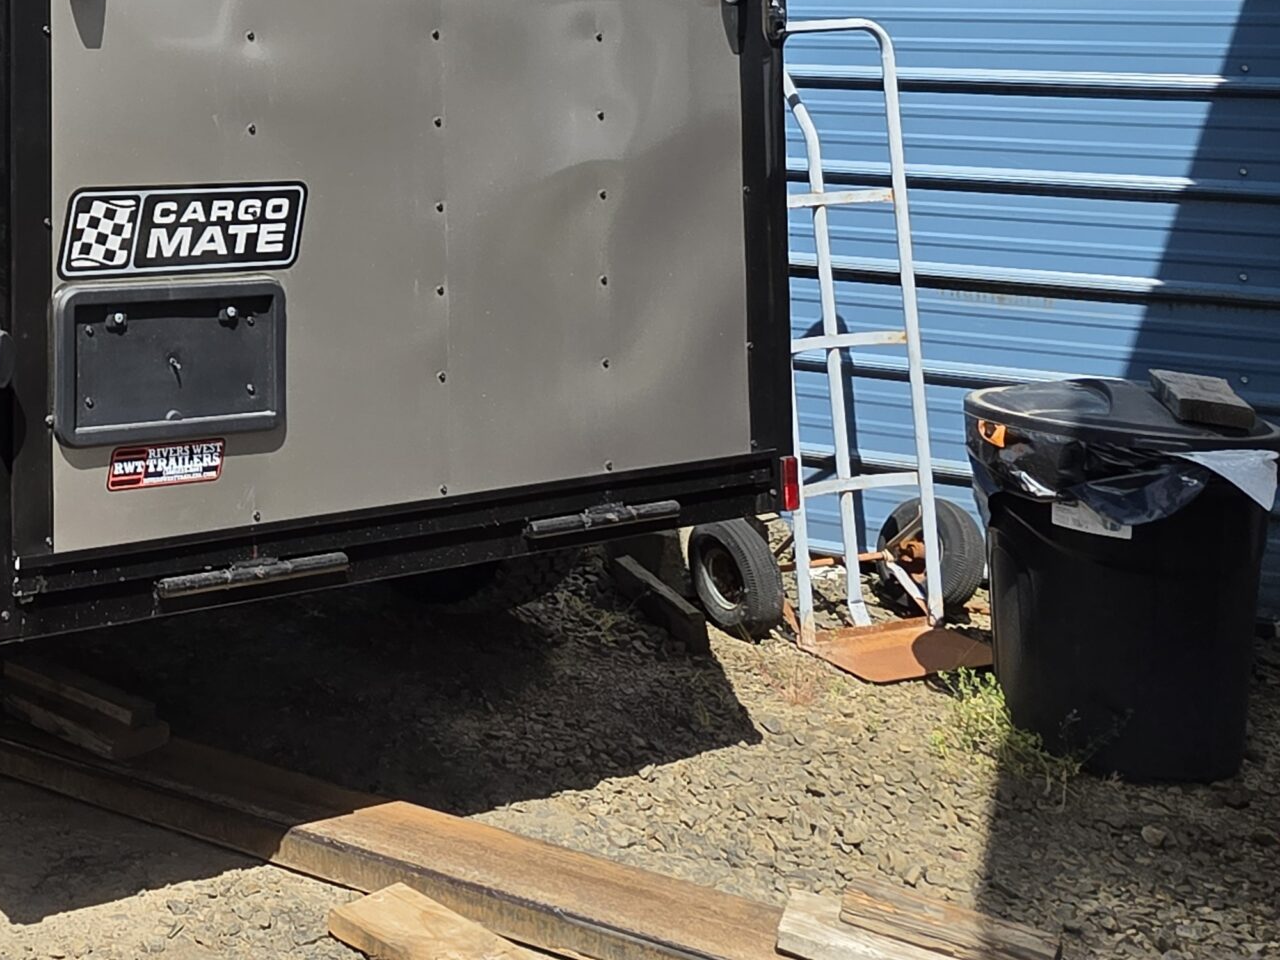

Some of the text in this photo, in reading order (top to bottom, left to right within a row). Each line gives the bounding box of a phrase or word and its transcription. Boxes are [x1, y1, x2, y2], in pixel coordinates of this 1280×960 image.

[153, 197, 290, 223] CARGO
[146, 223, 287, 258] MATE
[148, 442, 223, 458] RIVERS WEST
[113, 460, 145, 475] RWT
[146, 453, 221, 473] TRAILERS
